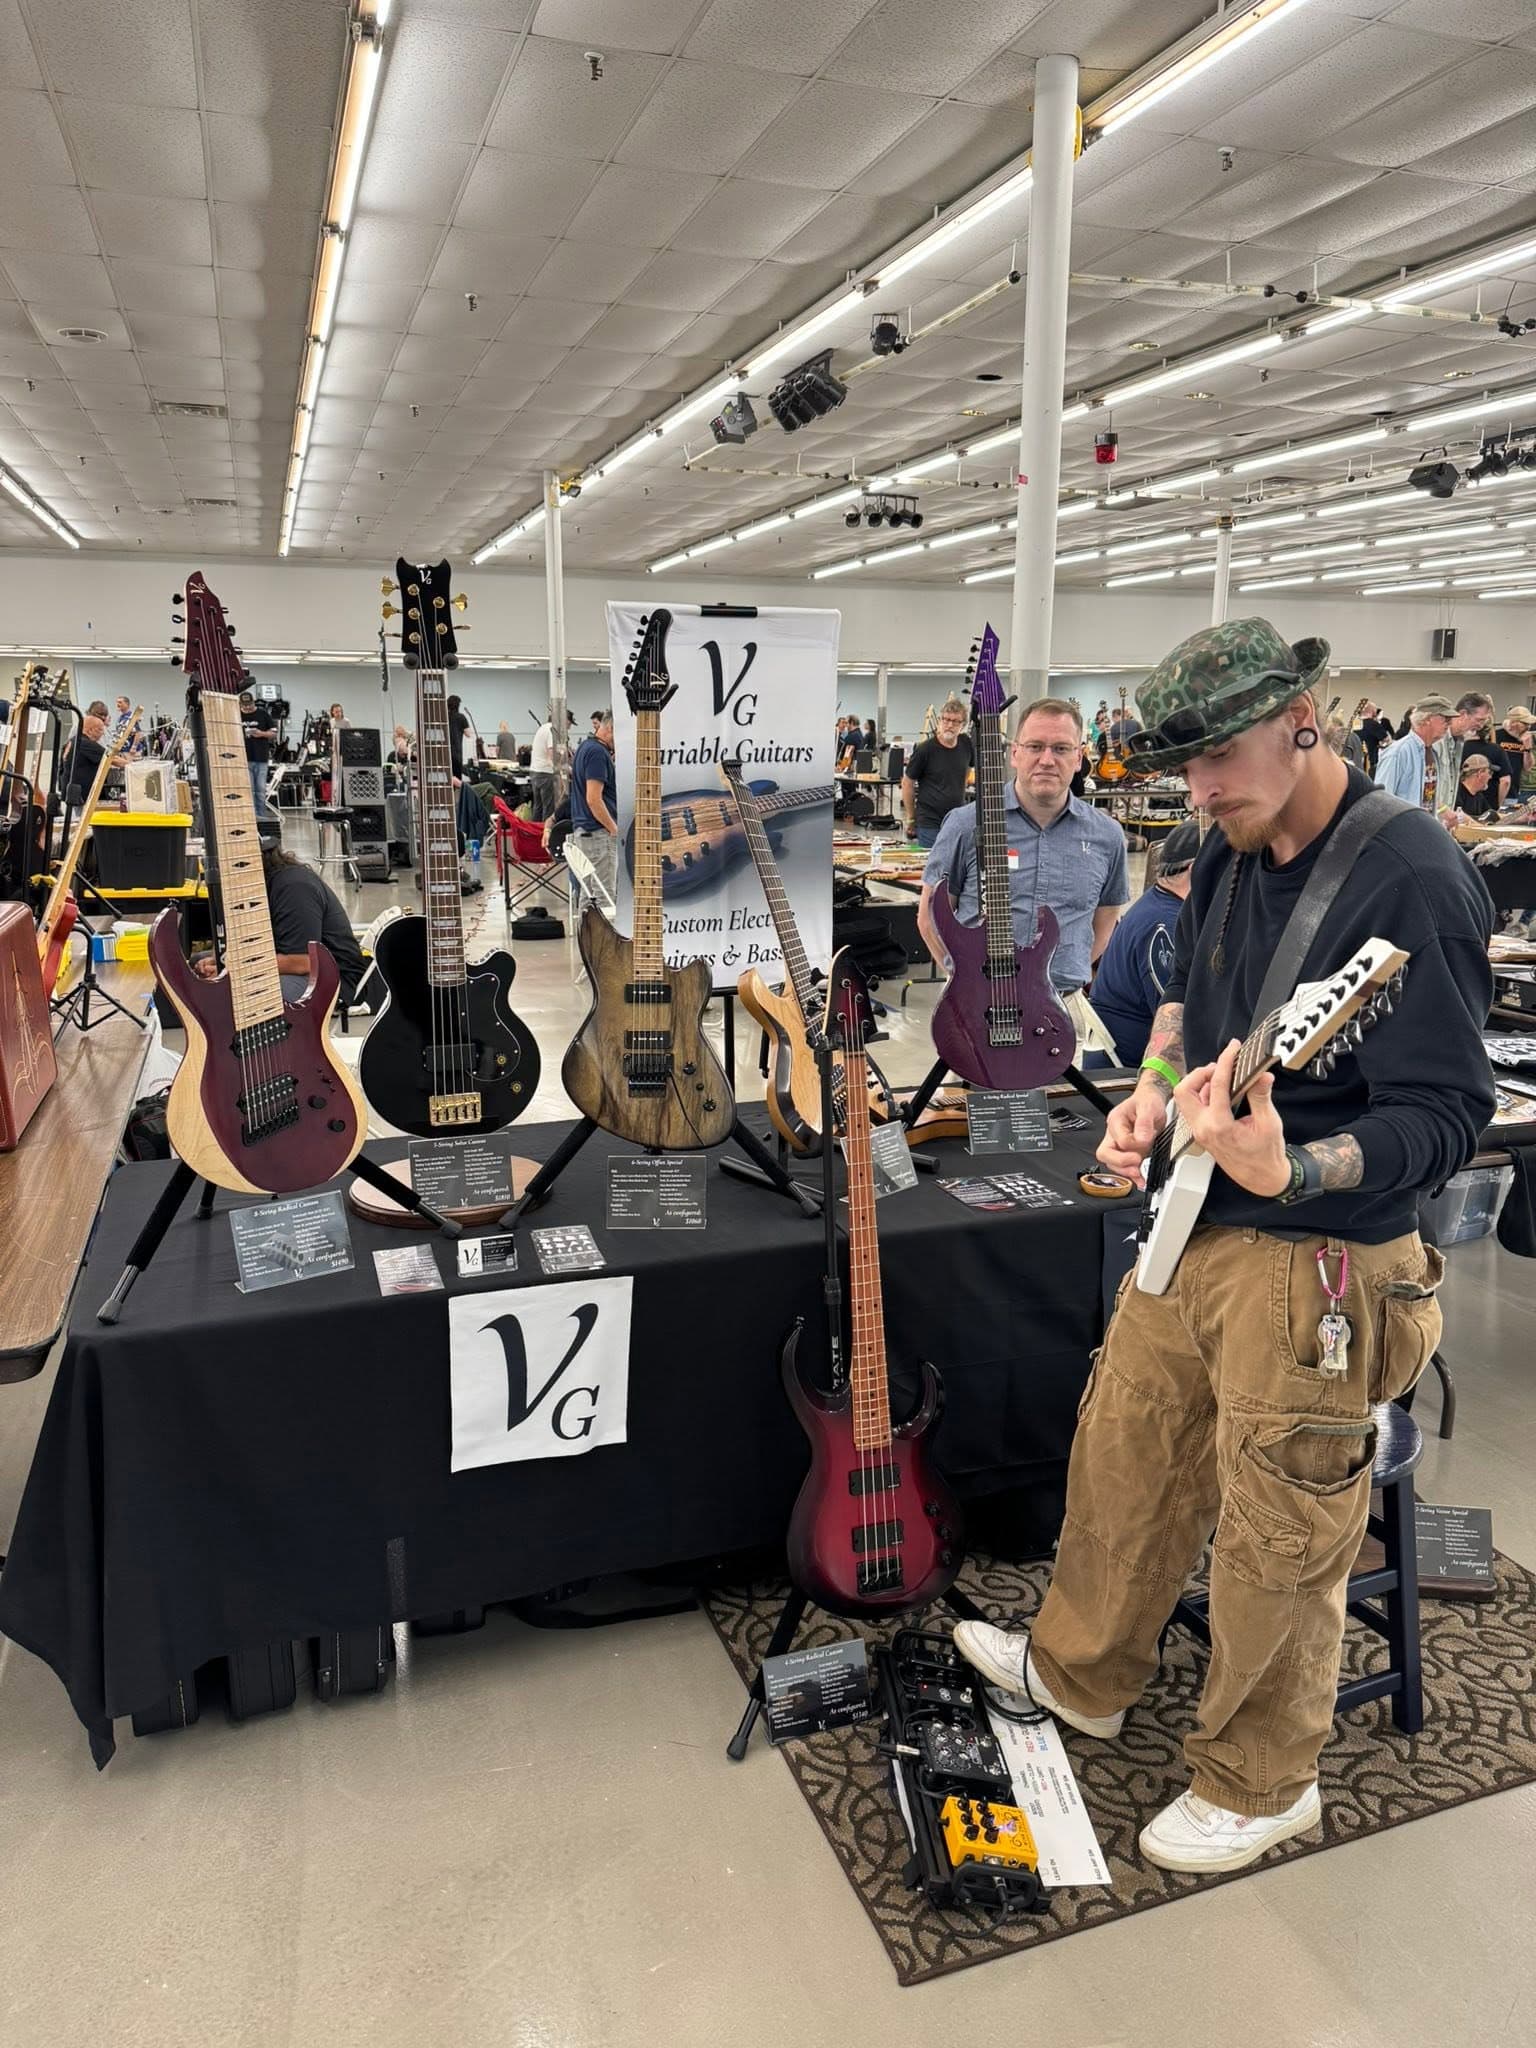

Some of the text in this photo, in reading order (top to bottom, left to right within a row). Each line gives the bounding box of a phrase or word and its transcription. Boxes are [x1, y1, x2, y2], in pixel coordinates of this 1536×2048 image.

[699, 640, 758, 727] VG
[736, 738, 814, 763] Guitars
[477, 1303, 600, 1440] VG
